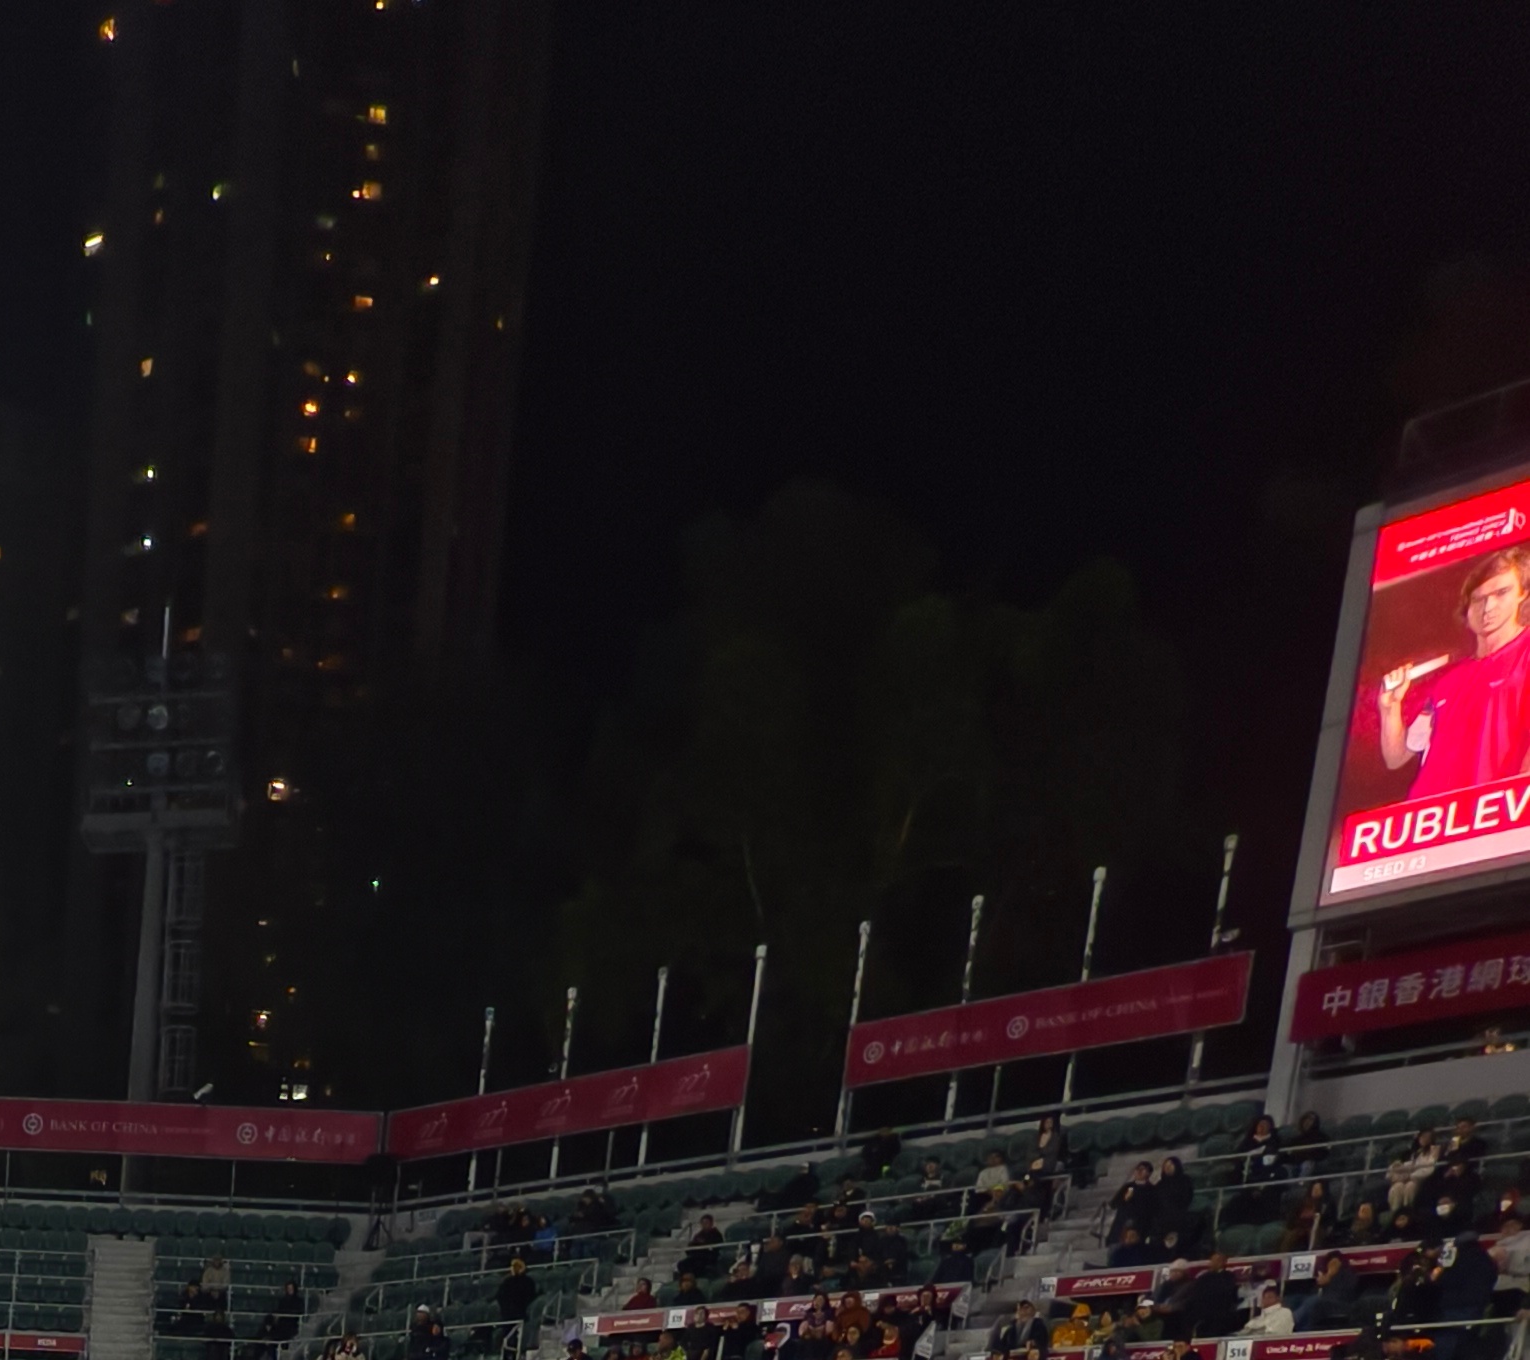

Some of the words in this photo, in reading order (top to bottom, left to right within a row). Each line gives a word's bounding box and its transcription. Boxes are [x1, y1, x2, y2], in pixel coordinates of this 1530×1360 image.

[1351, 783, 1530, 858] RUBLEV
[1363, 859, 1405, 882] SEED
[1407, 855, 1427, 872] #3
